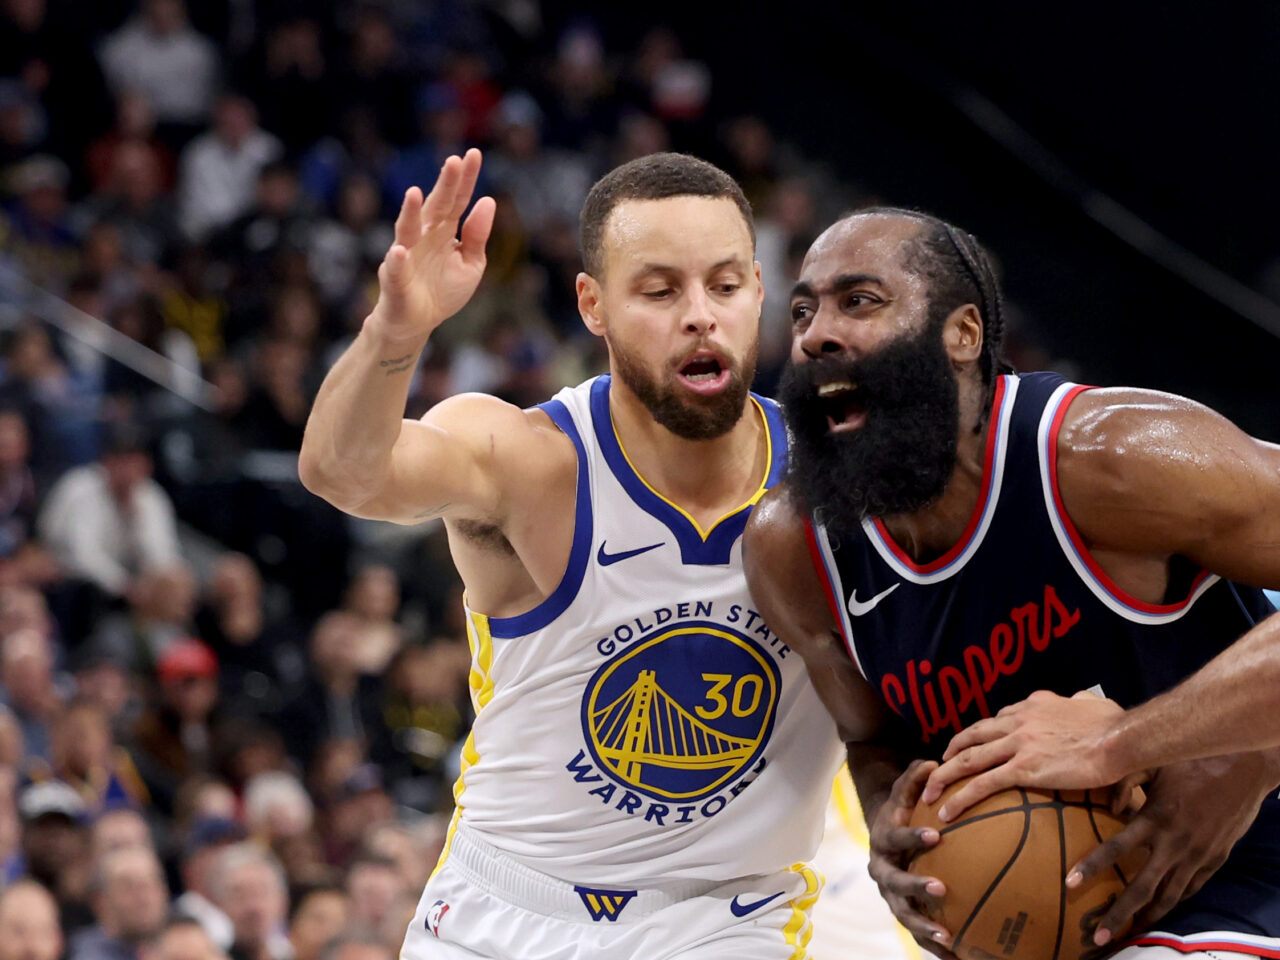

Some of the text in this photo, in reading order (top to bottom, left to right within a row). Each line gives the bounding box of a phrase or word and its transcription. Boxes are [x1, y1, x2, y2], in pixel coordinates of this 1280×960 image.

[596, 601, 713, 657] GOLDEN
[881, 584, 1081, 743] Clippers
[695, 673, 764, 719] 30
